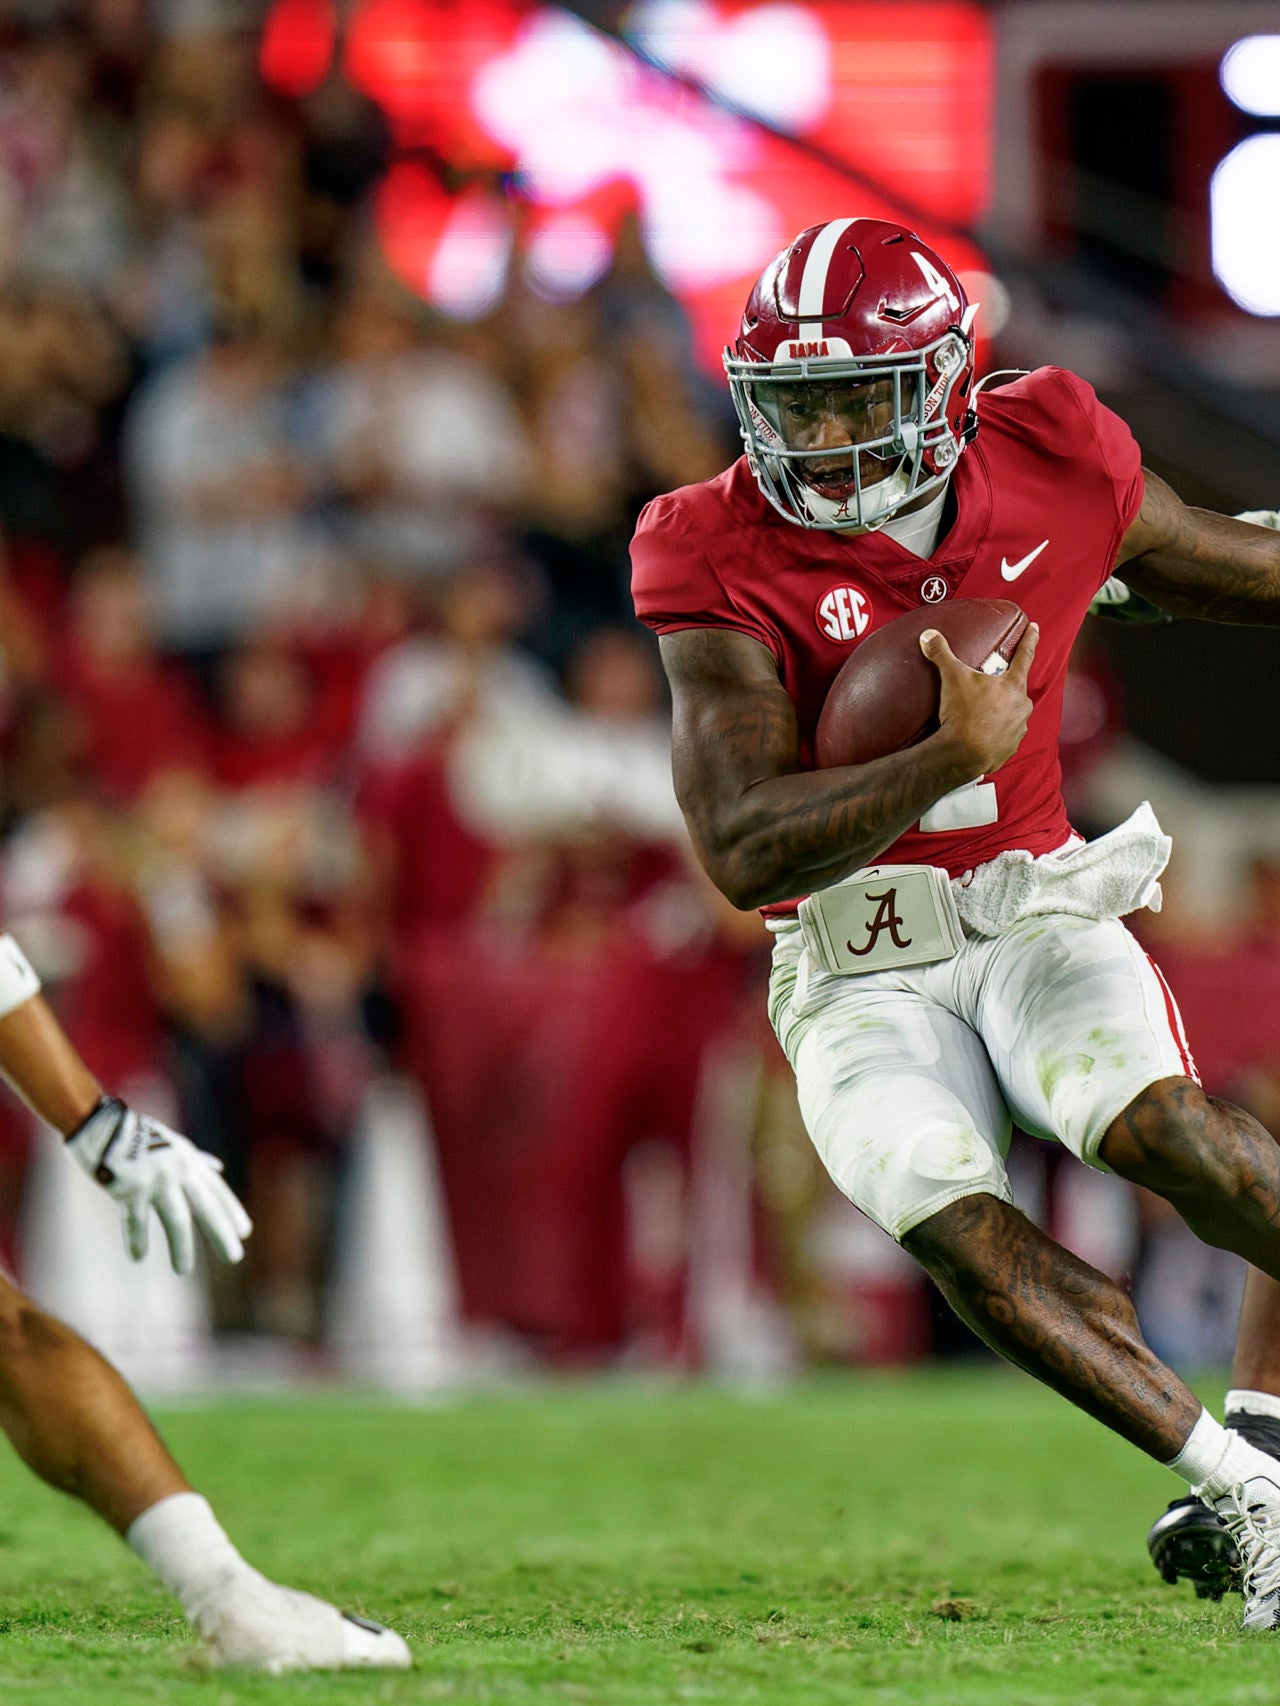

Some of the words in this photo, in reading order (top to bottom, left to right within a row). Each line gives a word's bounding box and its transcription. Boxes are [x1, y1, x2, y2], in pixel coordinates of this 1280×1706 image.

[910, 251, 960, 313] 4
[788, 341, 829, 359] BAMA
[933, 373, 950, 396] TIDE
[757, 418, 777, 442] TIDE
[819, 587, 869, 641] SEC
[846, 887, 912, 957] A
